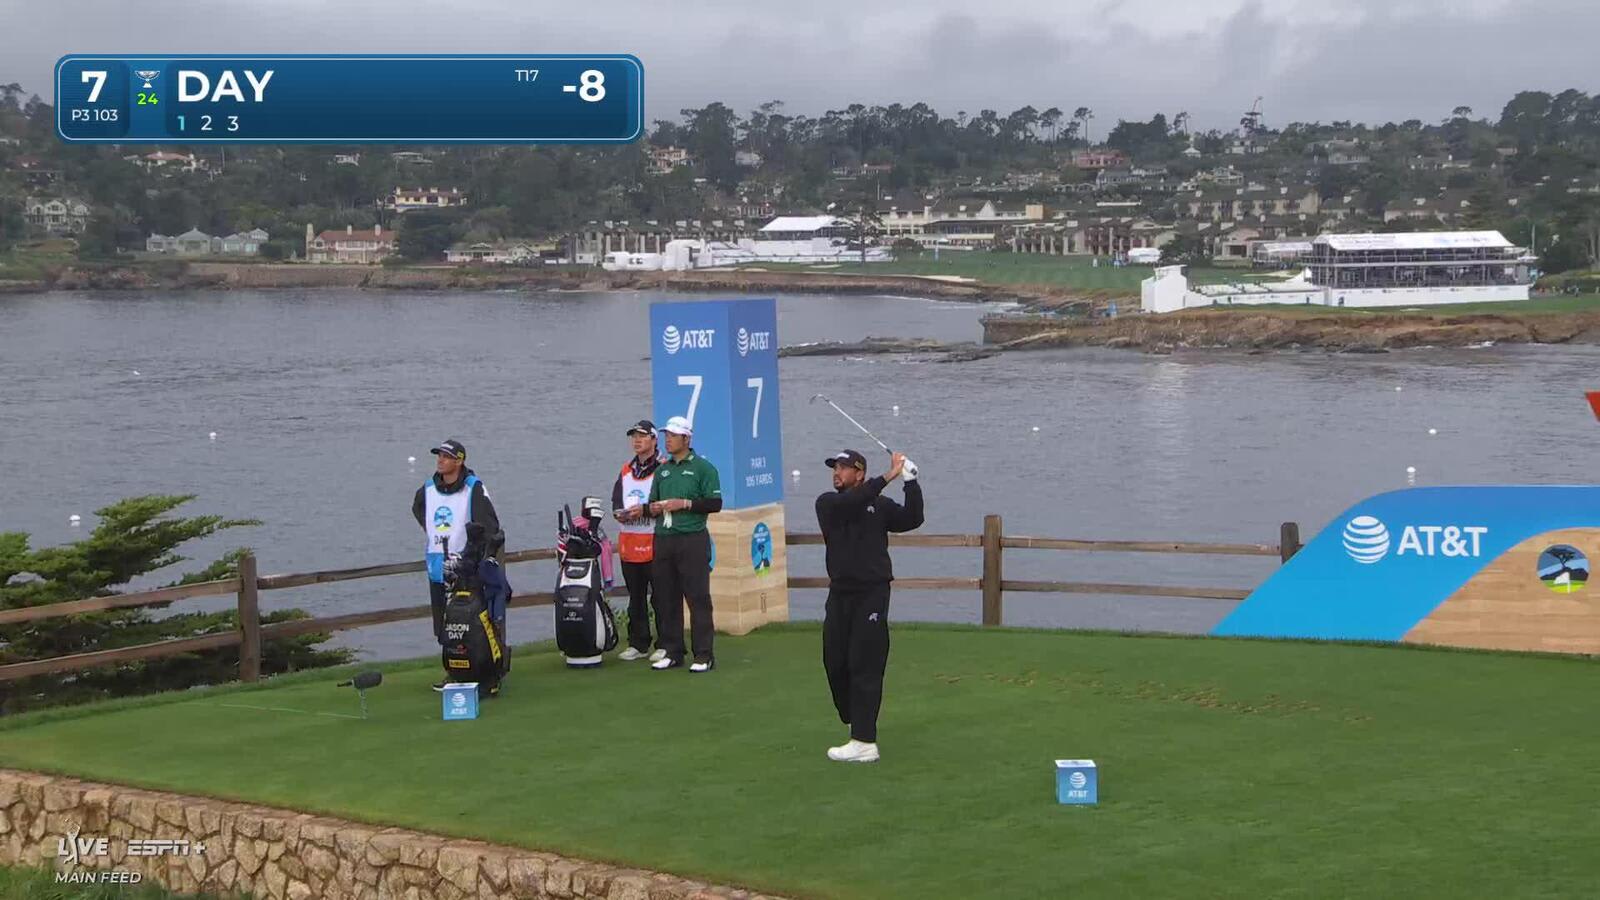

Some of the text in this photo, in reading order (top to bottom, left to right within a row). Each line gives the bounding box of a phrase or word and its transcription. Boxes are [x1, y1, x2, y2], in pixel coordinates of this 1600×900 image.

[681, 329, 716, 349] AT&T
[749, 332, 770, 351] AT&T
[677, 375, 703, 430] 7
[747, 377, 764, 438] 7
[1396, 525, 1489, 557] AT&T
[445, 623, 470, 632] JASON
[448, 631, 465, 640] DAY
